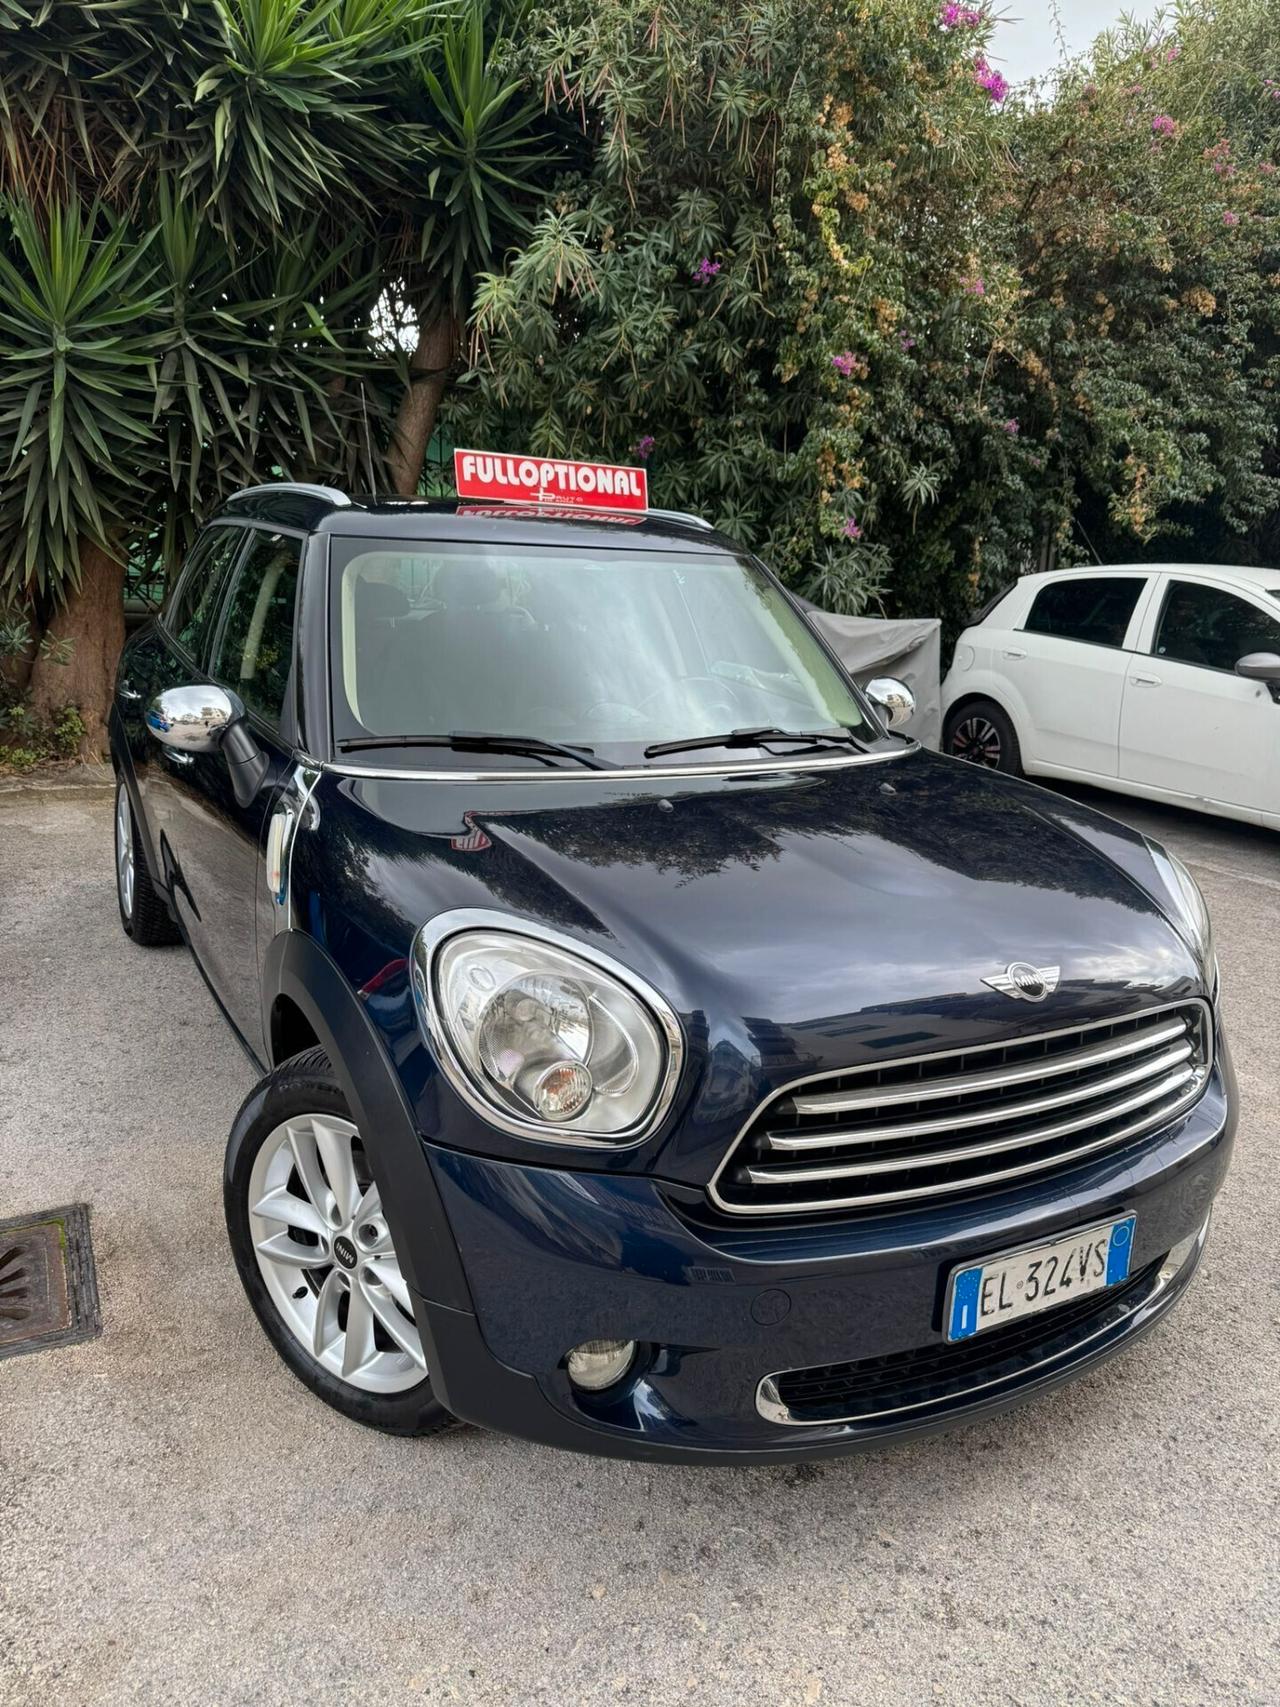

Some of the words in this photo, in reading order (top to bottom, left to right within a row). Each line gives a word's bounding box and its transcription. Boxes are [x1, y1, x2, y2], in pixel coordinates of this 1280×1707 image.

[462, 454, 642, 496] FULLOPTIONAL
[981, 1272, 1014, 1316] EL
[1024, 1239, 1108, 1301] 324VS
